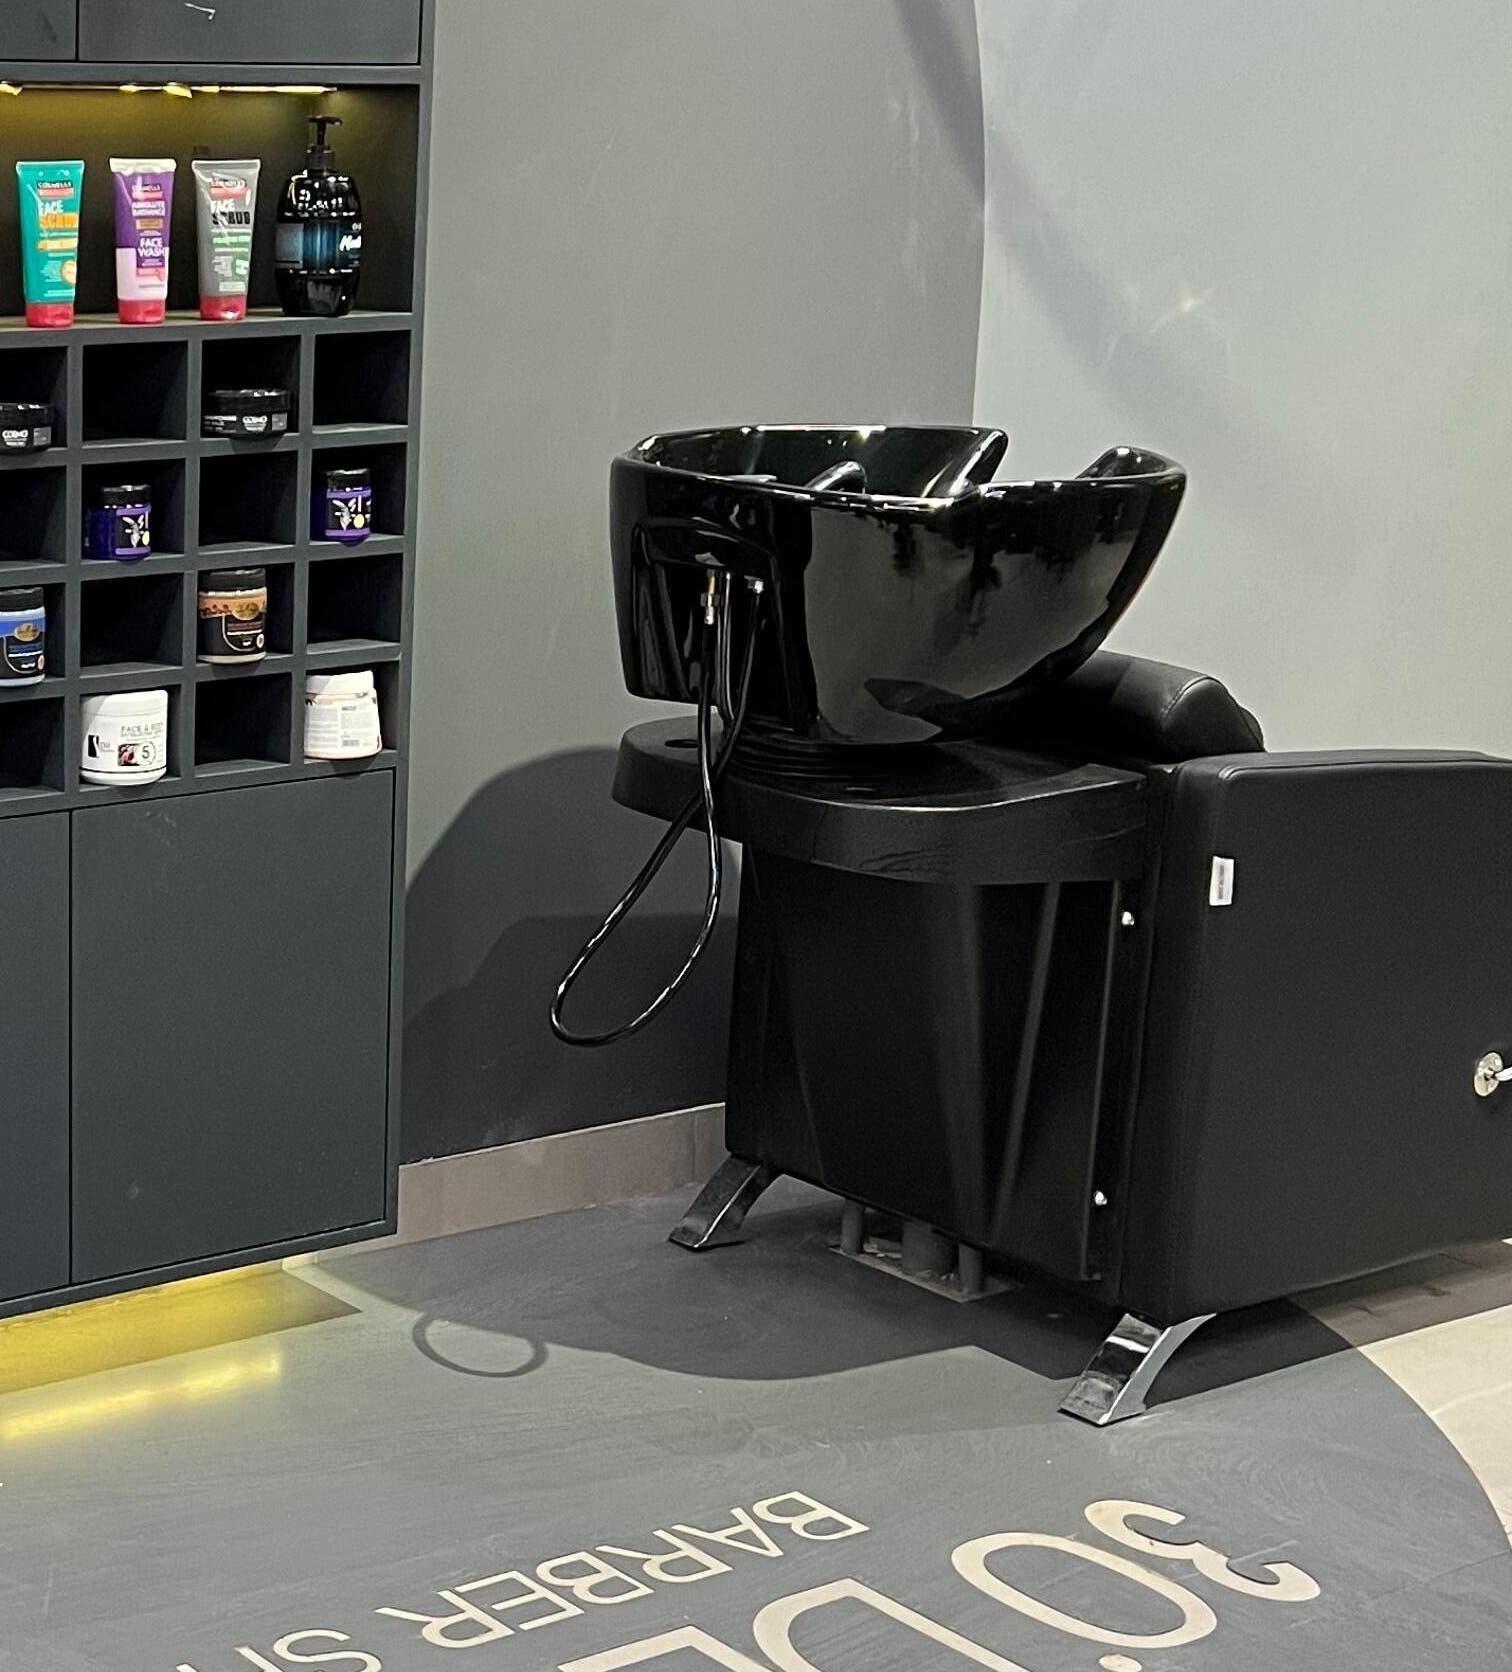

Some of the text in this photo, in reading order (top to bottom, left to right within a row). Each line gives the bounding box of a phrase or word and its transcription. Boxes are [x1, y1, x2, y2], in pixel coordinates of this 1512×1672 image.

[38, 200, 64, 215] FACE
[210, 199, 236, 212] FACE
[140, 237, 163, 248] FACE
[137, 247, 166, 258] WASH
[141, 745, 150, 759] 5
[374, 1490, 870, 1649] BARBER
